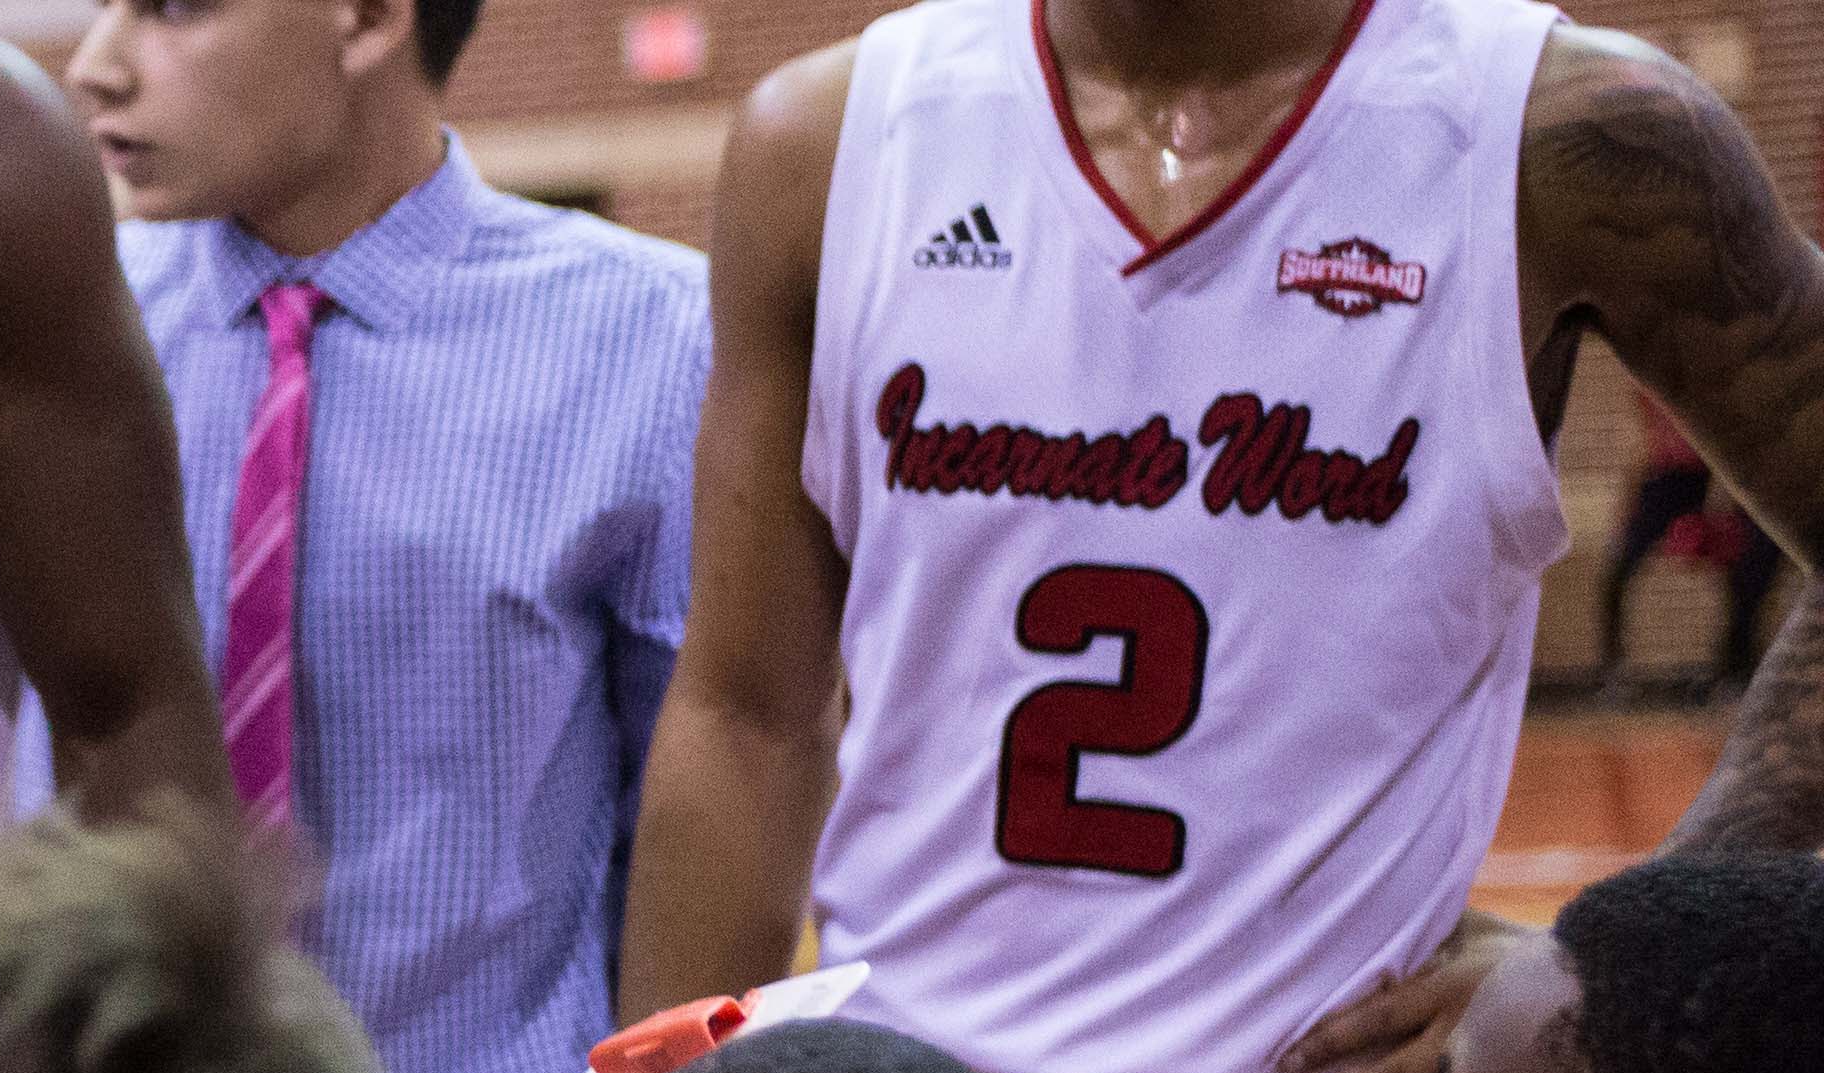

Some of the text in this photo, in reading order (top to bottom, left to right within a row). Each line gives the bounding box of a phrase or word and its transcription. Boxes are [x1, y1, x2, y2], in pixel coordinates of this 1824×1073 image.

[1279, 250, 1425, 300] SOUTHLAND
[876, 363, 1420, 525] Incarnate Word
[994, 562, 1210, 879] 2
